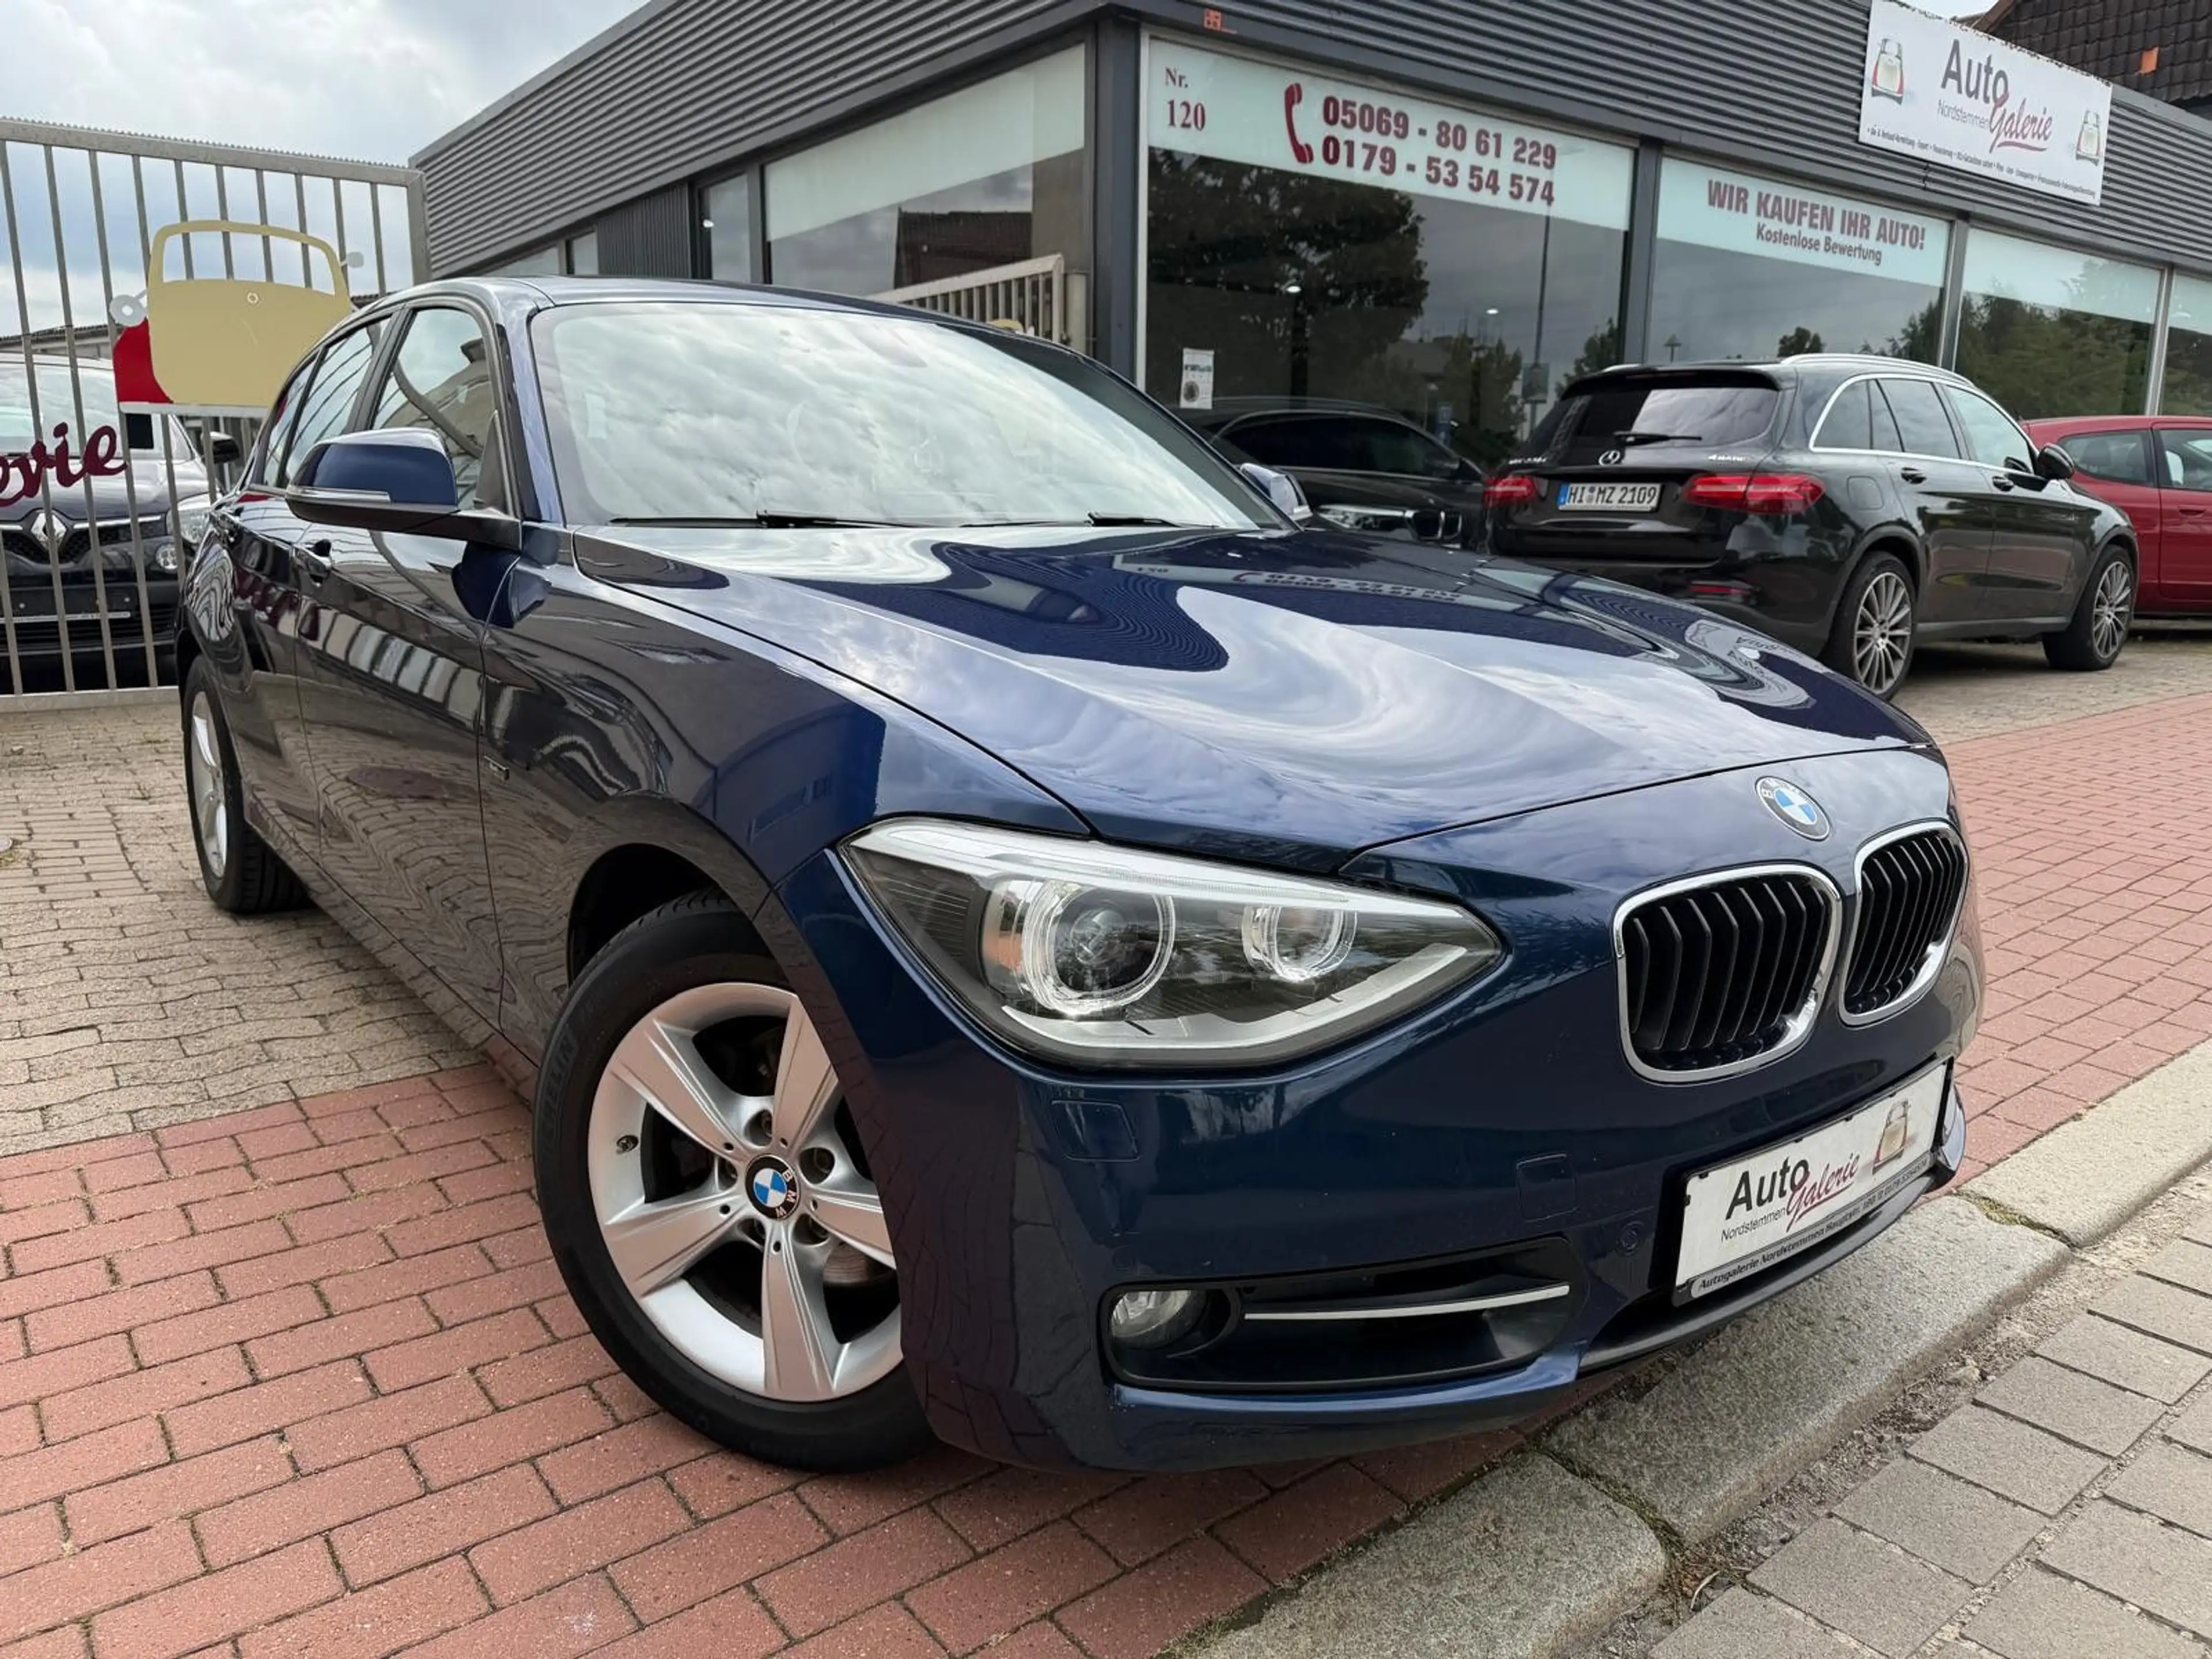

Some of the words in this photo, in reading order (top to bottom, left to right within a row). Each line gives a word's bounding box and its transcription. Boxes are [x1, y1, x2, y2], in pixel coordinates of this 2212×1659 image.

[1165, 67, 1189, 88] Nr.
[1941, 39, 2009, 108] Auto
[1167, 99, 1206, 131] 120
[1323, 96, 1410, 140] 05069
[1435, 120, 1467, 151] 80
[1475, 128, 1502, 158] 61
[1513, 137, 1556, 171] 229
[1990, 92, 2053, 154] Galerie
[1322, 135, 1397, 176] 0179
[1425, 156, 1460, 188] 53
[1468, 165, 1501, 195] 54
[1509, 173, 1555, 207] 574
[1707, 179, 1749, 214] WIR
[1756, 191, 1835, 232] KAUFEN
[1840, 209, 1872, 240] IHR
[1876, 218, 1926, 250] AUTO!
[1756, 222, 1821, 251] Kostenlose
[1824, 236, 1883, 266] Bewertung
[1568, 486, 1586, 504] HI
[1595, 486, 1616, 504] MZ
[1618, 486, 1657, 505] 2109
[774, 1169, 797, 1220] BMW
[1725, 1157, 1810, 1220] Auto
[1786, 1152, 1860, 1233] Galerie
[1721, 1207, 1785, 1242] Nordstemmen
[1700, 1258, 1760, 1289] Autogalerie
